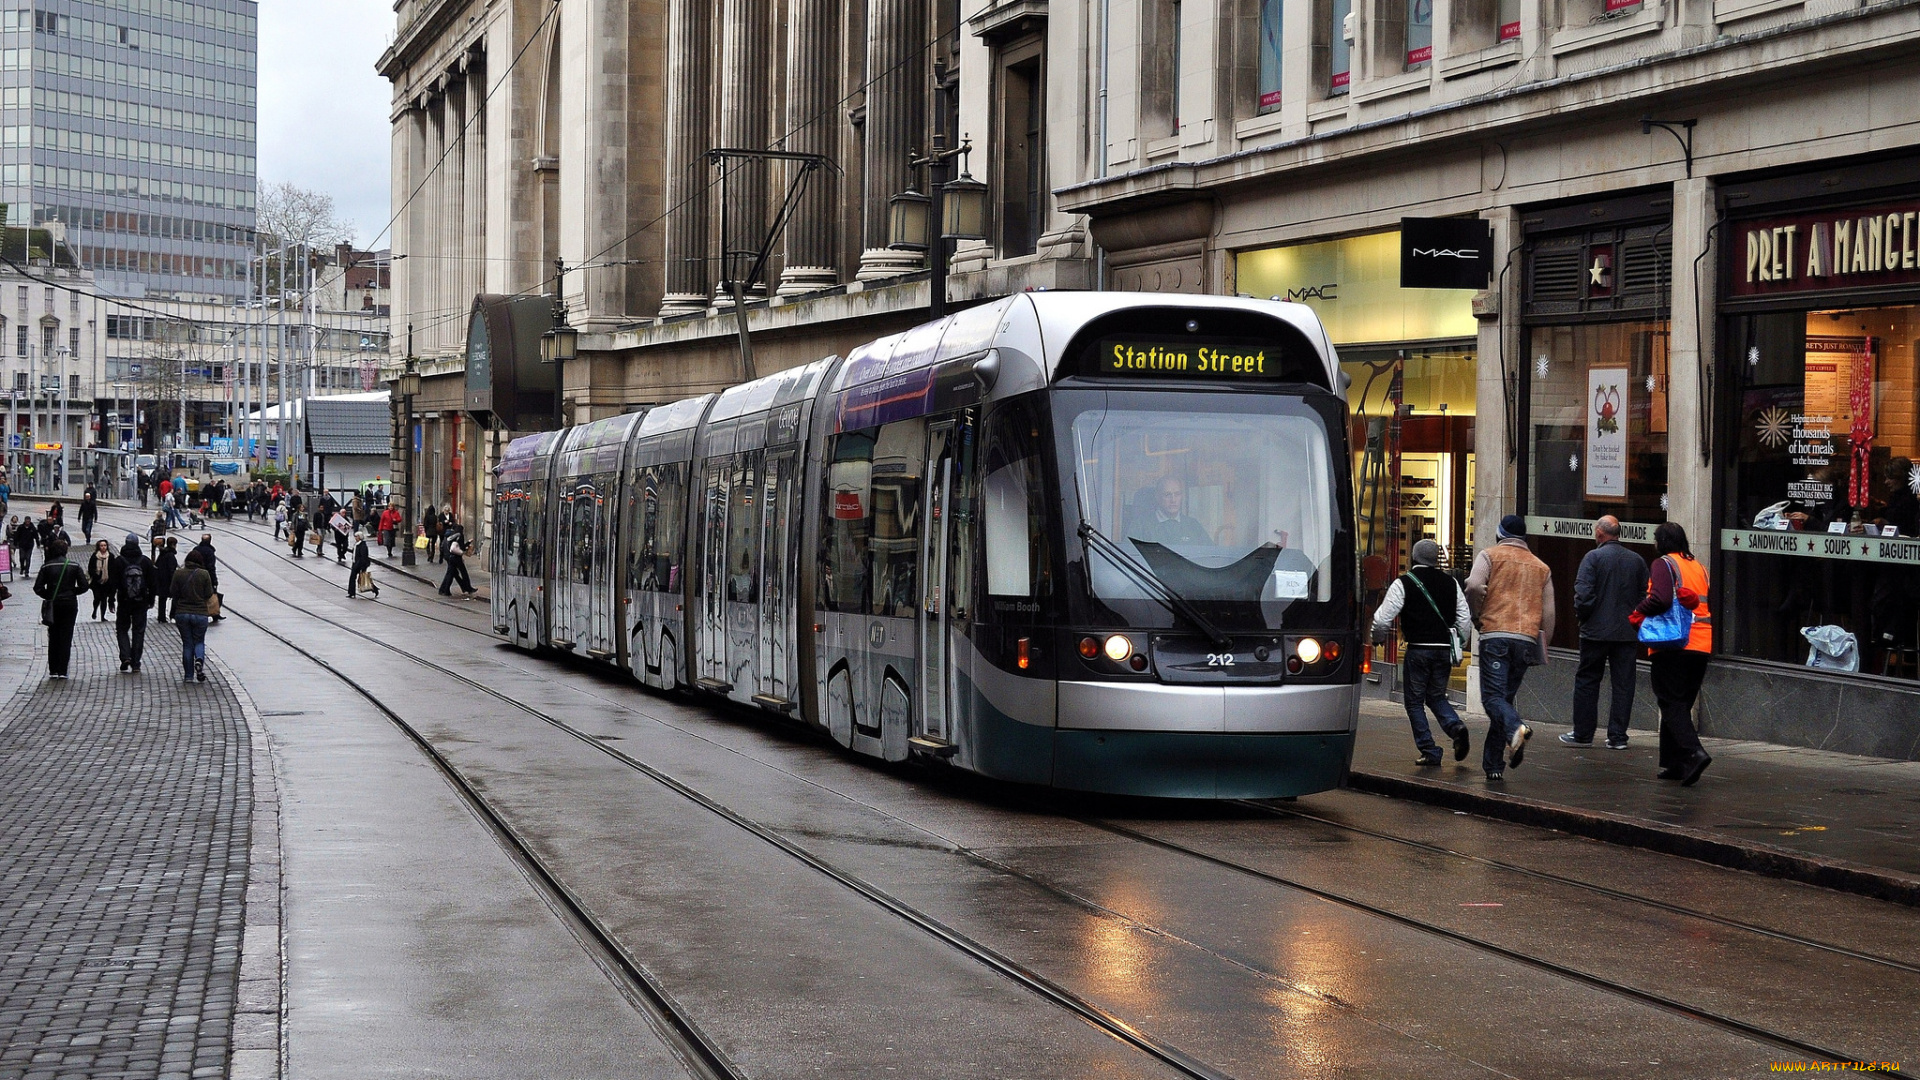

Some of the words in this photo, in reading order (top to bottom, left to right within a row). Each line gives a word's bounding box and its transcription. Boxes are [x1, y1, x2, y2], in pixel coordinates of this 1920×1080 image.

[1747, 225, 1796, 282] PRET
[1806, 224, 1822, 277] A
[1834, 211, 1920, 275] MANGE
[1113, 344, 1188, 370] Station
[1198, 347, 1265, 373] Street
[1792, 424, 1831, 439] thousands
[1788, 439, 1797, 454] of
[1798, 439, 1811, 454] hot
[1812, 440, 1834, 455] meals
[1792, 457, 1799, 465] to
[1799, 455, 1807, 465] the
[1807, 455, 1829, 466] homeless
[1787, 490, 1814, 499] CHRISTMAS
[1814, 491, 1833, 500] DINNER
[1554, 520, 1593, 536] SANDWICHES
[1619, 525, 1647, 540] NDMADE
[1748, 533, 1798, 552] SANDWICHES
[1824, 538, 1850, 556] SOUPS
[1016, 601, 1041, 612] Booth
[1206, 653, 1236, 666] 212
